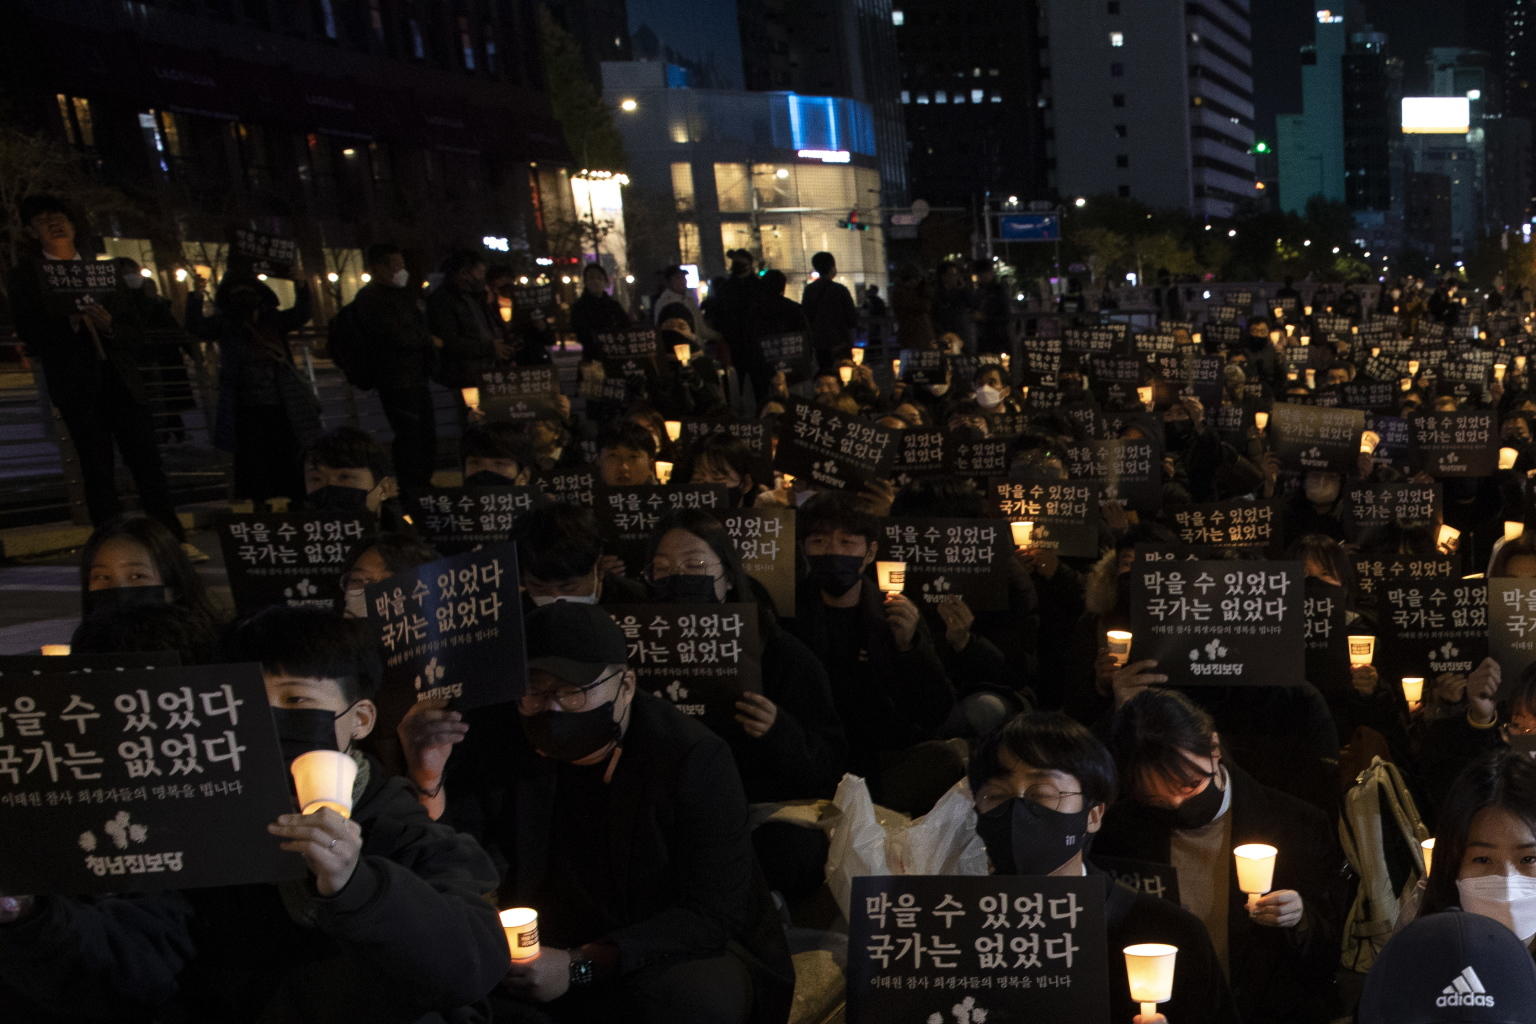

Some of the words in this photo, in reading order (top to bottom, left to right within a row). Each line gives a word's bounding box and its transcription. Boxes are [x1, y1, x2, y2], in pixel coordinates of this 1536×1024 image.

[230, 523, 271, 542] 막을
[276, 523, 297, 542] 수
[302, 520, 366, 541] 있었다
[885, 525, 919, 543] 막을
[924, 527, 941, 543] 수
[947, 526, 998, 543] 있었다
[239, 544, 299, 565] 국가는
[304, 542, 351, 563] 없었
[889, 545, 939, 563] 국가는
[945, 546, 995, 564] 없었다
[376, 588, 406, 621] 막을
[411, 581, 430, 606] 수
[437, 559, 504, 599] 있었다
[1144, 571, 1186, 596] 막을
[1193, 572, 1216, 595] 수
[1224, 571, 1291, 596] 있었다
[381, 614, 429, 650] 국가는
[437, 592, 503, 633] 없었다
[1147, 598, 1213, 621] 국가는
[1221, 598, 1288, 622] 없었다
[0, 696, 46, 738] 을
[59, 694, 101, 735] 수
[113, 684, 244, 733] 있었다
[118, 730, 247, 778] 없었다
[866, 892, 922, 929] 막을
[931, 894, 967, 929] 수
[978, 892, 1084, 930] 있었다
[866, 932, 961, 969] 국가는
[974, 932, 1080, 969] 없었다
[1436, 992, 1495, 1008] adidas
